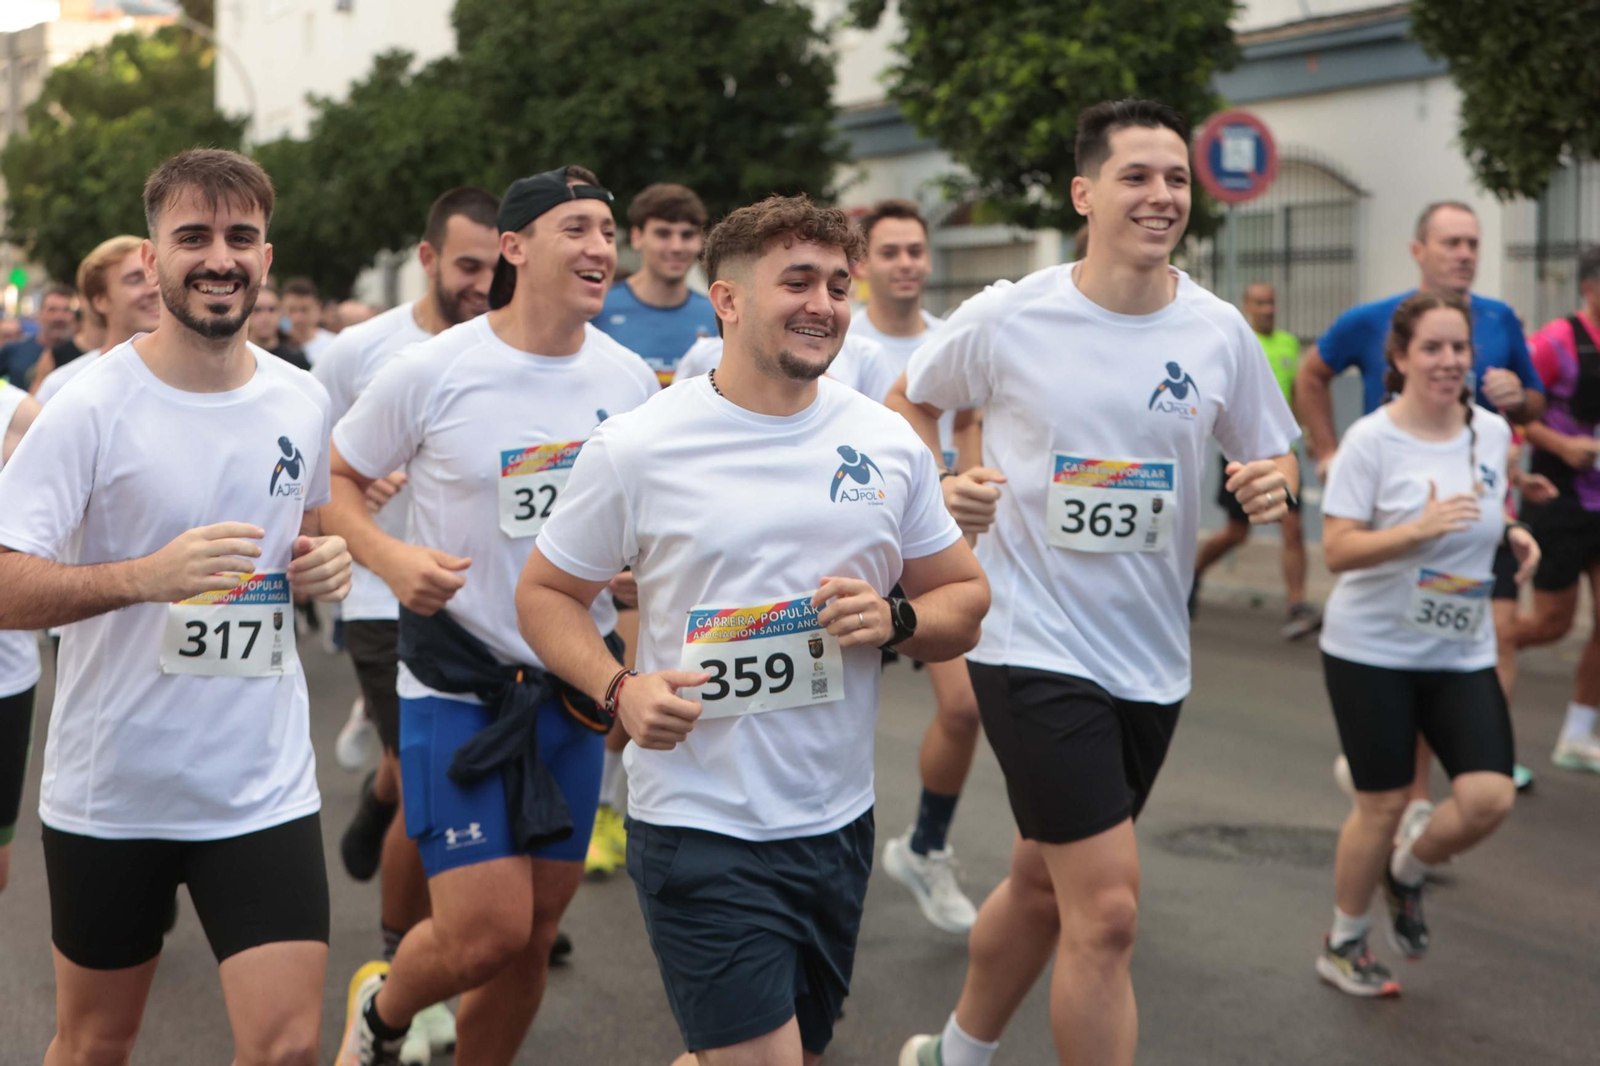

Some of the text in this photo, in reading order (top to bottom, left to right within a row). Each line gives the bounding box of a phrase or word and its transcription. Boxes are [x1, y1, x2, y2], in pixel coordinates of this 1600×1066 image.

[1062, 461, 1166, 479] CARRERA POPULAR
[514, 484, 557, 521] 32
[1061, 499, 1138, 538] 363
[238, 593, 266, 602] SANTO
[241, 580, 283, 591] POPULAR
[693, 619, 818, 640] ASOCIACION SANTO ANG
[695, 605, 820, 629] CARRERA POPULAR
[1415, 598, 1472, 632] 366
[178, 620, 262, 660] 317
[700, 652, 795, 702] 359
